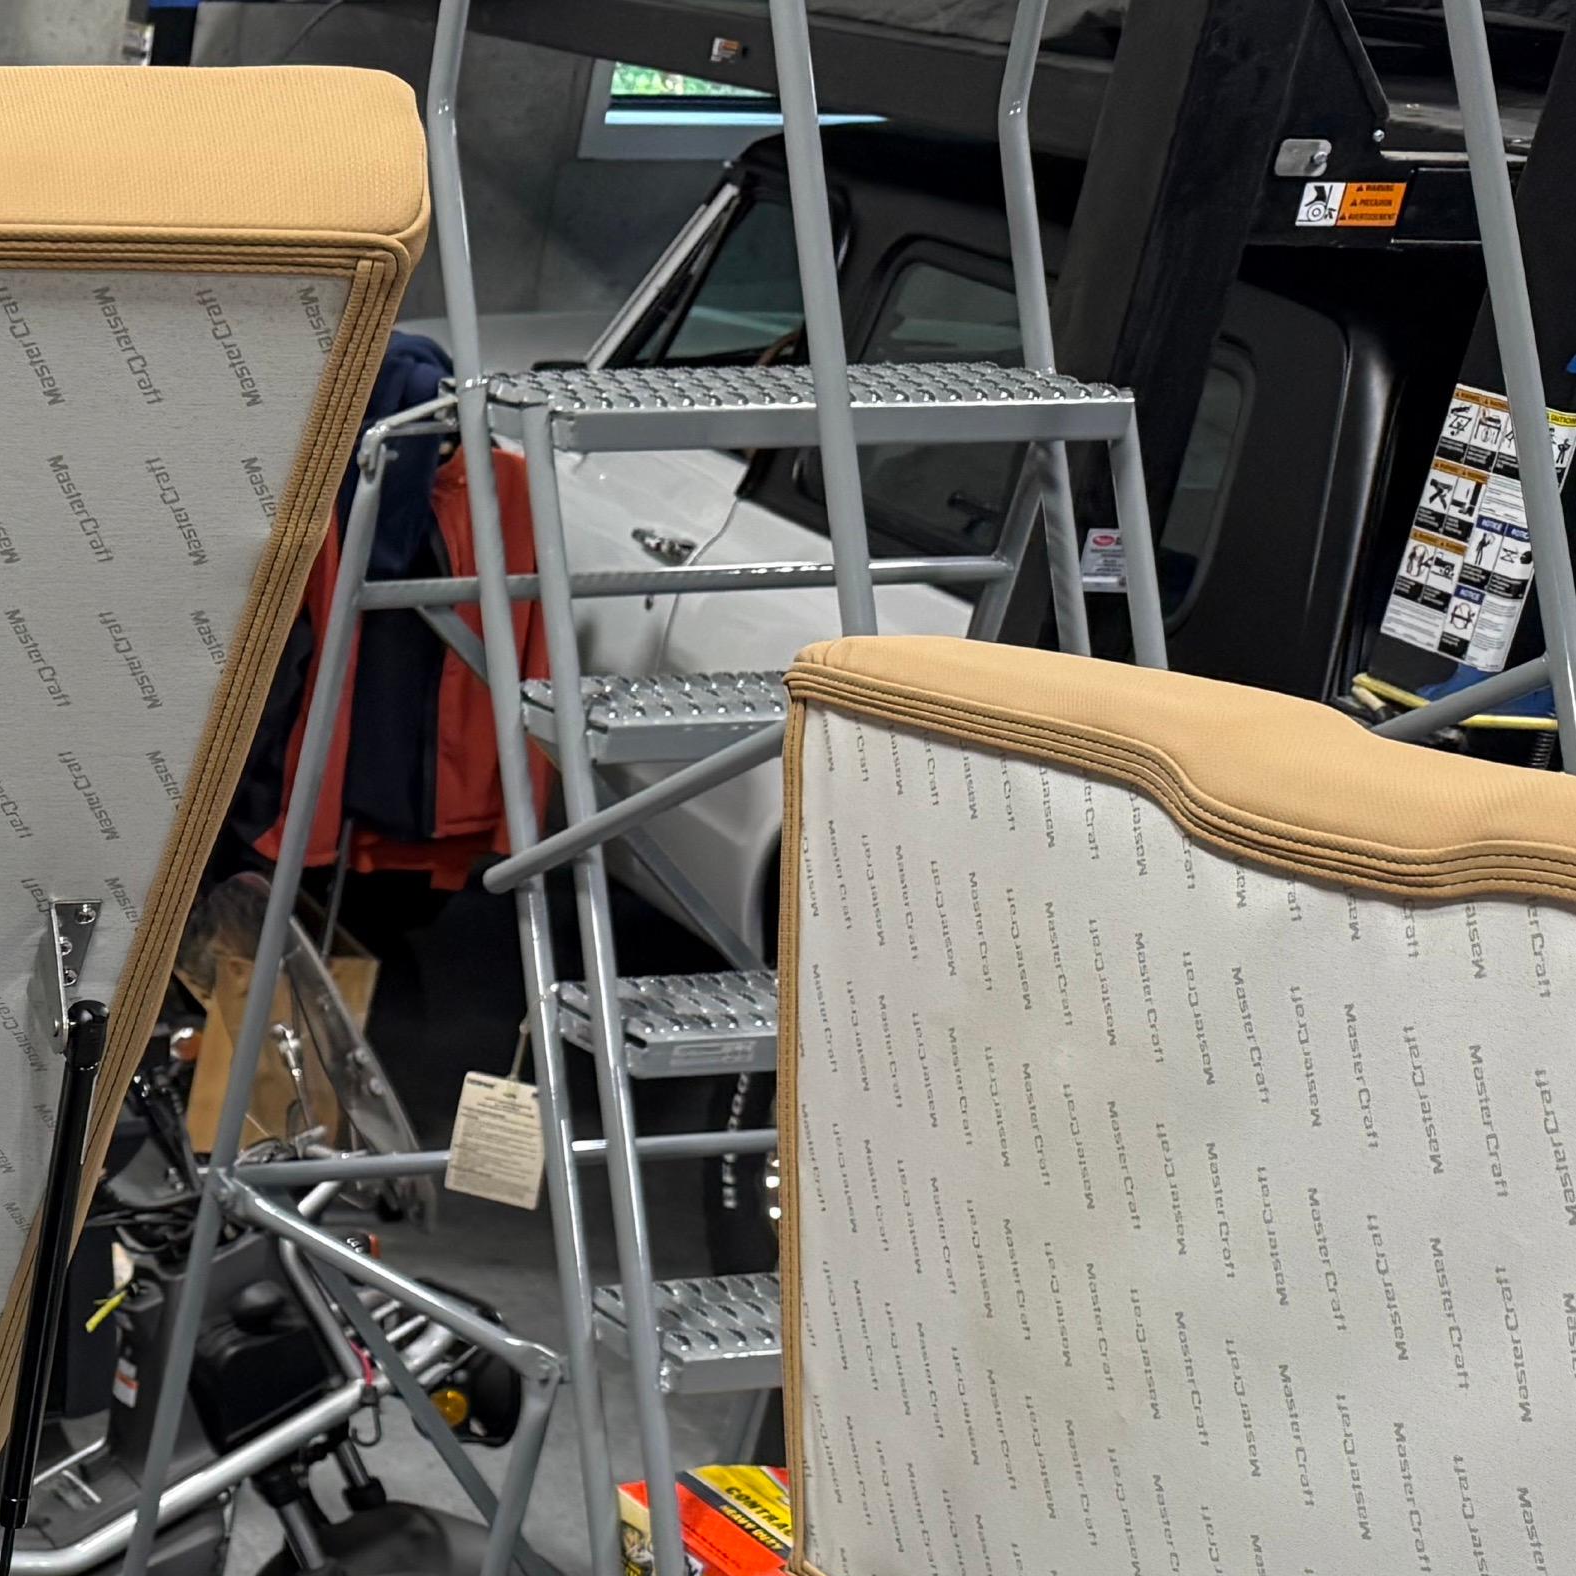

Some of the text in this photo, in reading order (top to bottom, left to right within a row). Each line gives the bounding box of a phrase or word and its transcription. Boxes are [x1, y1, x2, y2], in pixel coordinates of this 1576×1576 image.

[194, 287, 265, 409] MasterCraft
[143, 455, 210, 568] MasterCraft
[96, 610, 164, 711] MasterCraft
[56, 749, 121, 842] MasterCraft
[1133, 930, 1166, 1065] MasterCraft
[1288, 984, 1324, 1129] MasterCraft
[1401, 1024, 1446, 1176] MasterCraft
[1306, 1186, 1349, 1332] MasterCraft
[1493, 1265, 1535, 1424] MasterCraft
[1391, 1420, 1434, 1574] MasterCraft
